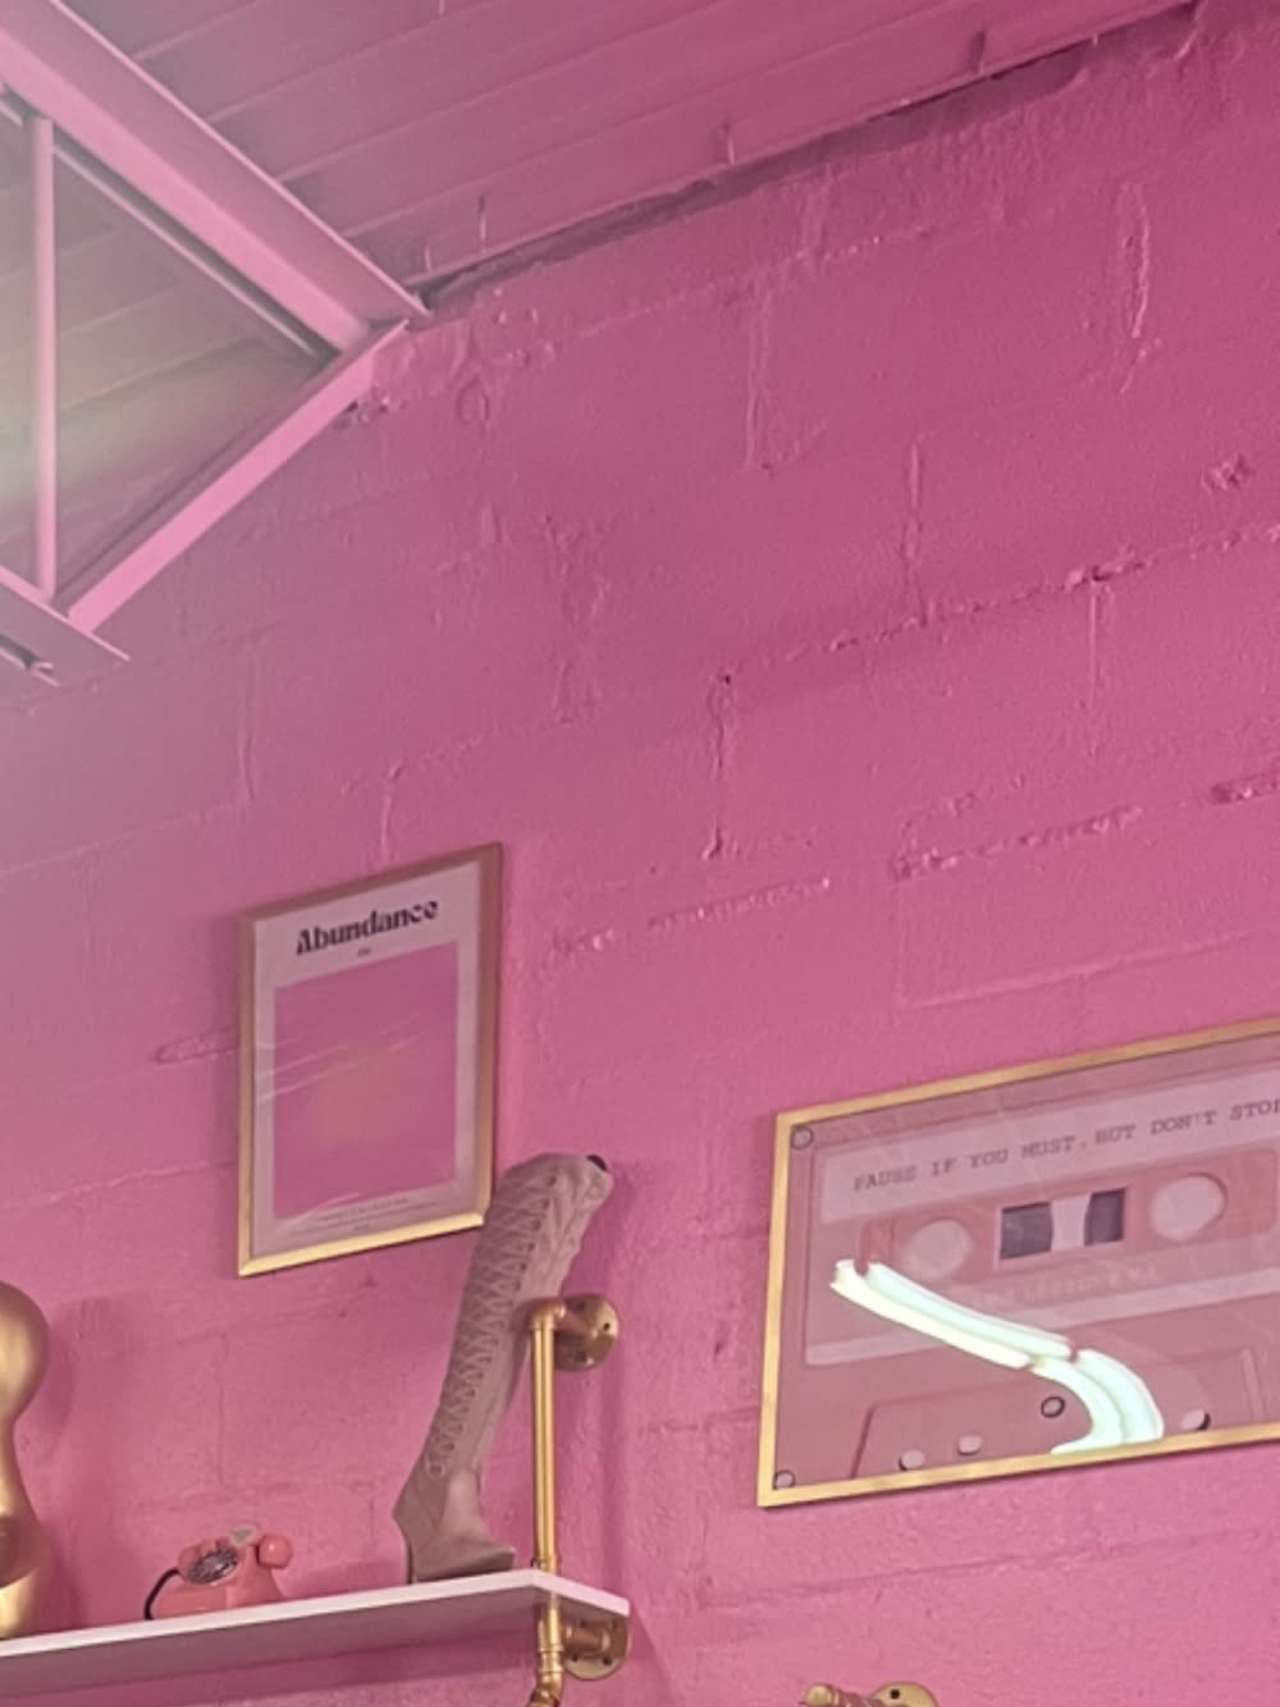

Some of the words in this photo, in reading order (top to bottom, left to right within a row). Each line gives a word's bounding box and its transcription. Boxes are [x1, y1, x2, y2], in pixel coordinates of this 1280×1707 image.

[296, 899, 439, 955] Abundance
[853, 1165, 917, 1192] PAUSE
[932, 1157, 957, 1177] IF
[970, 1149, 1009, 1168] YOU
[1095, 1123, 1136, 1145] BUT
[1151, 1110, 1217, 1135] DON'T
